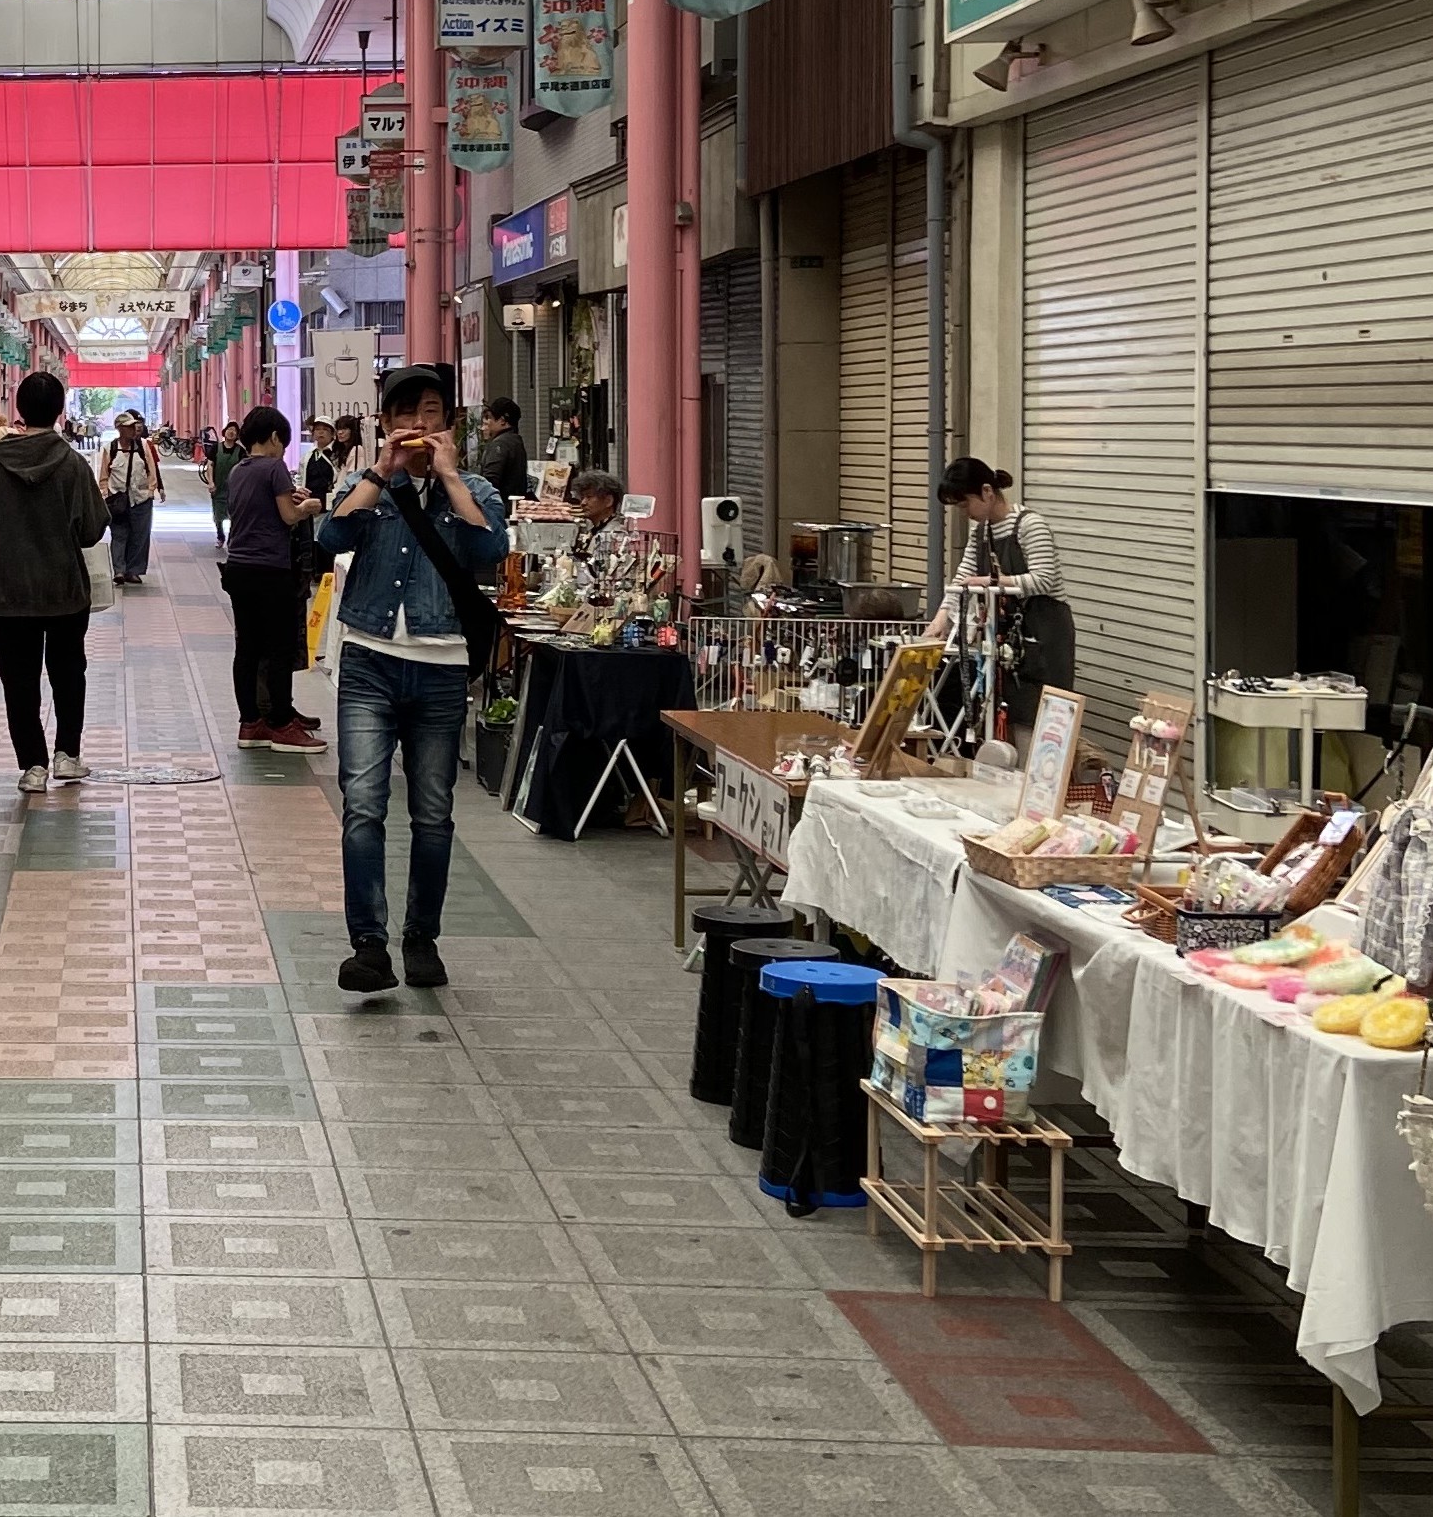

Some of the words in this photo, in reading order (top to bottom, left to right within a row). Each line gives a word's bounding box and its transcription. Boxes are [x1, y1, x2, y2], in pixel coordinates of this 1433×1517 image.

[442, 18, 474, 30] Action
[476, 18, 524, 33] イズミ
[456, 76, 508, 89] 沖縄
[539, 79, 611, 93] 平尾本通商店街
[118, 299, 176, 314] ええやん大正
